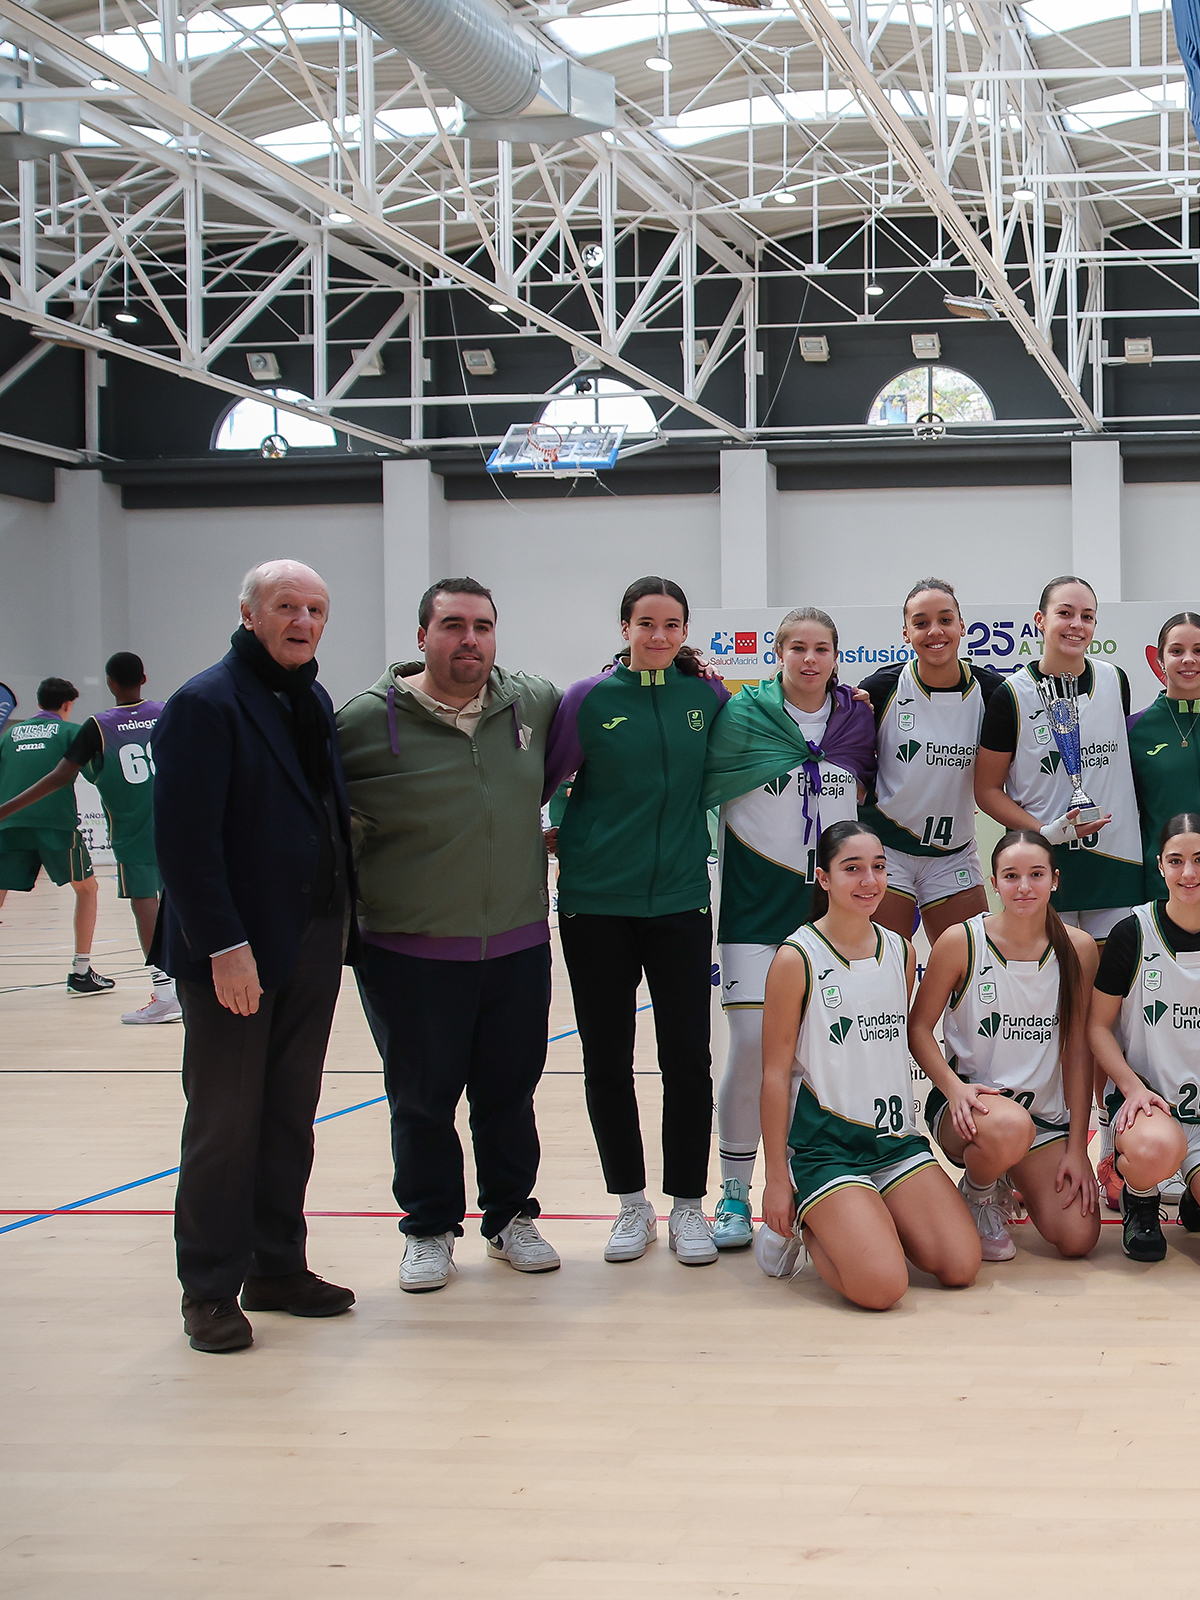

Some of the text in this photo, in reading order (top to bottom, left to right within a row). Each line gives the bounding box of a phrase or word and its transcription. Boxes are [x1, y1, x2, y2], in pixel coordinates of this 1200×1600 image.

[967, 622, 1015, 656] 25
[1019, 640, 1117, 655] A T DO
[838, 645, 916, 663] nsfusió
[11, 724, 59, 738] UNICAJA
[1080, 740, 1118, 756] ndación
[926, 754, 971, 770] Unicaja
[1080, 754, 1109, 769] nicaja
[920, 816, 954, 847] 14
[860, 1025, 899, 1042] Unicaja
[1003, 1027, 1051, 1044] Unicaja
[873, 1095, 904, 1137] 28
